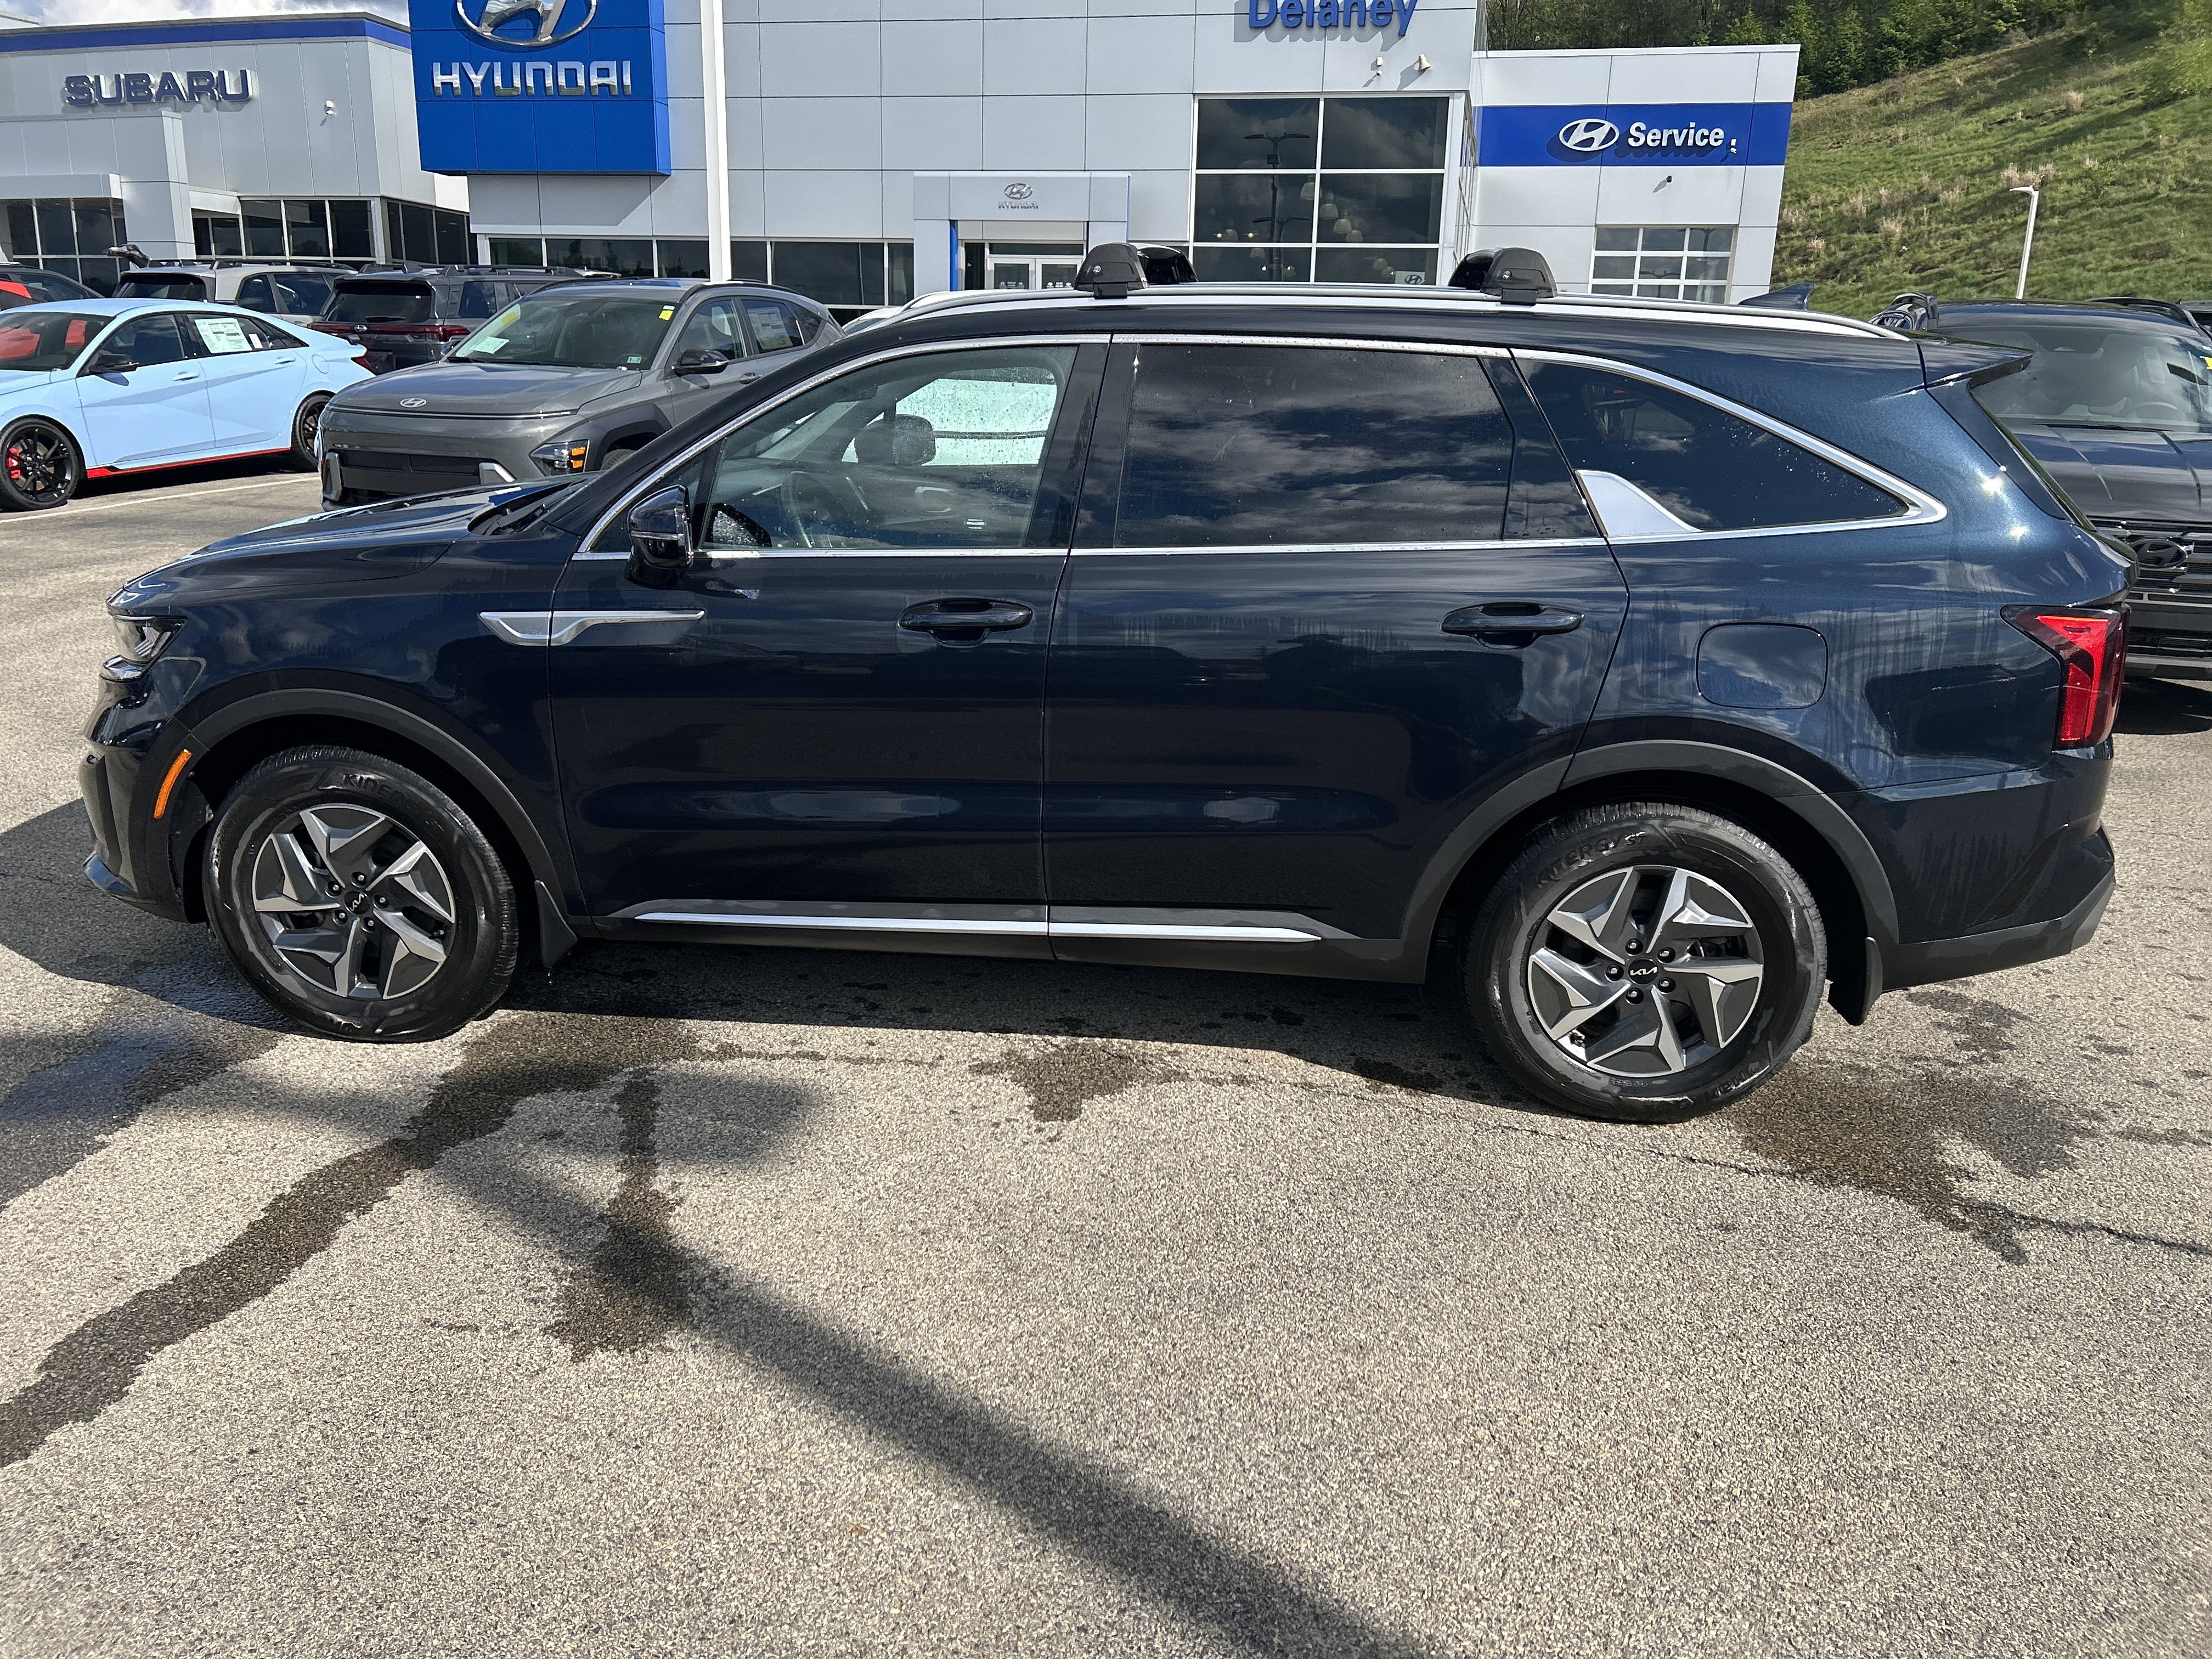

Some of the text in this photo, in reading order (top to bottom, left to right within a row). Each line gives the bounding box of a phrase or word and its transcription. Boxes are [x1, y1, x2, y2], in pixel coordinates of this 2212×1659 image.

[1249, 0, 1418, 36] Delaney
[64, 69, 253, 106] SUBARU
[432, 60, 632, 97] HYUNDAI
[1628, 121, 1725, 147] Service
[998, 201, 1039, 209] HYUNDAI
